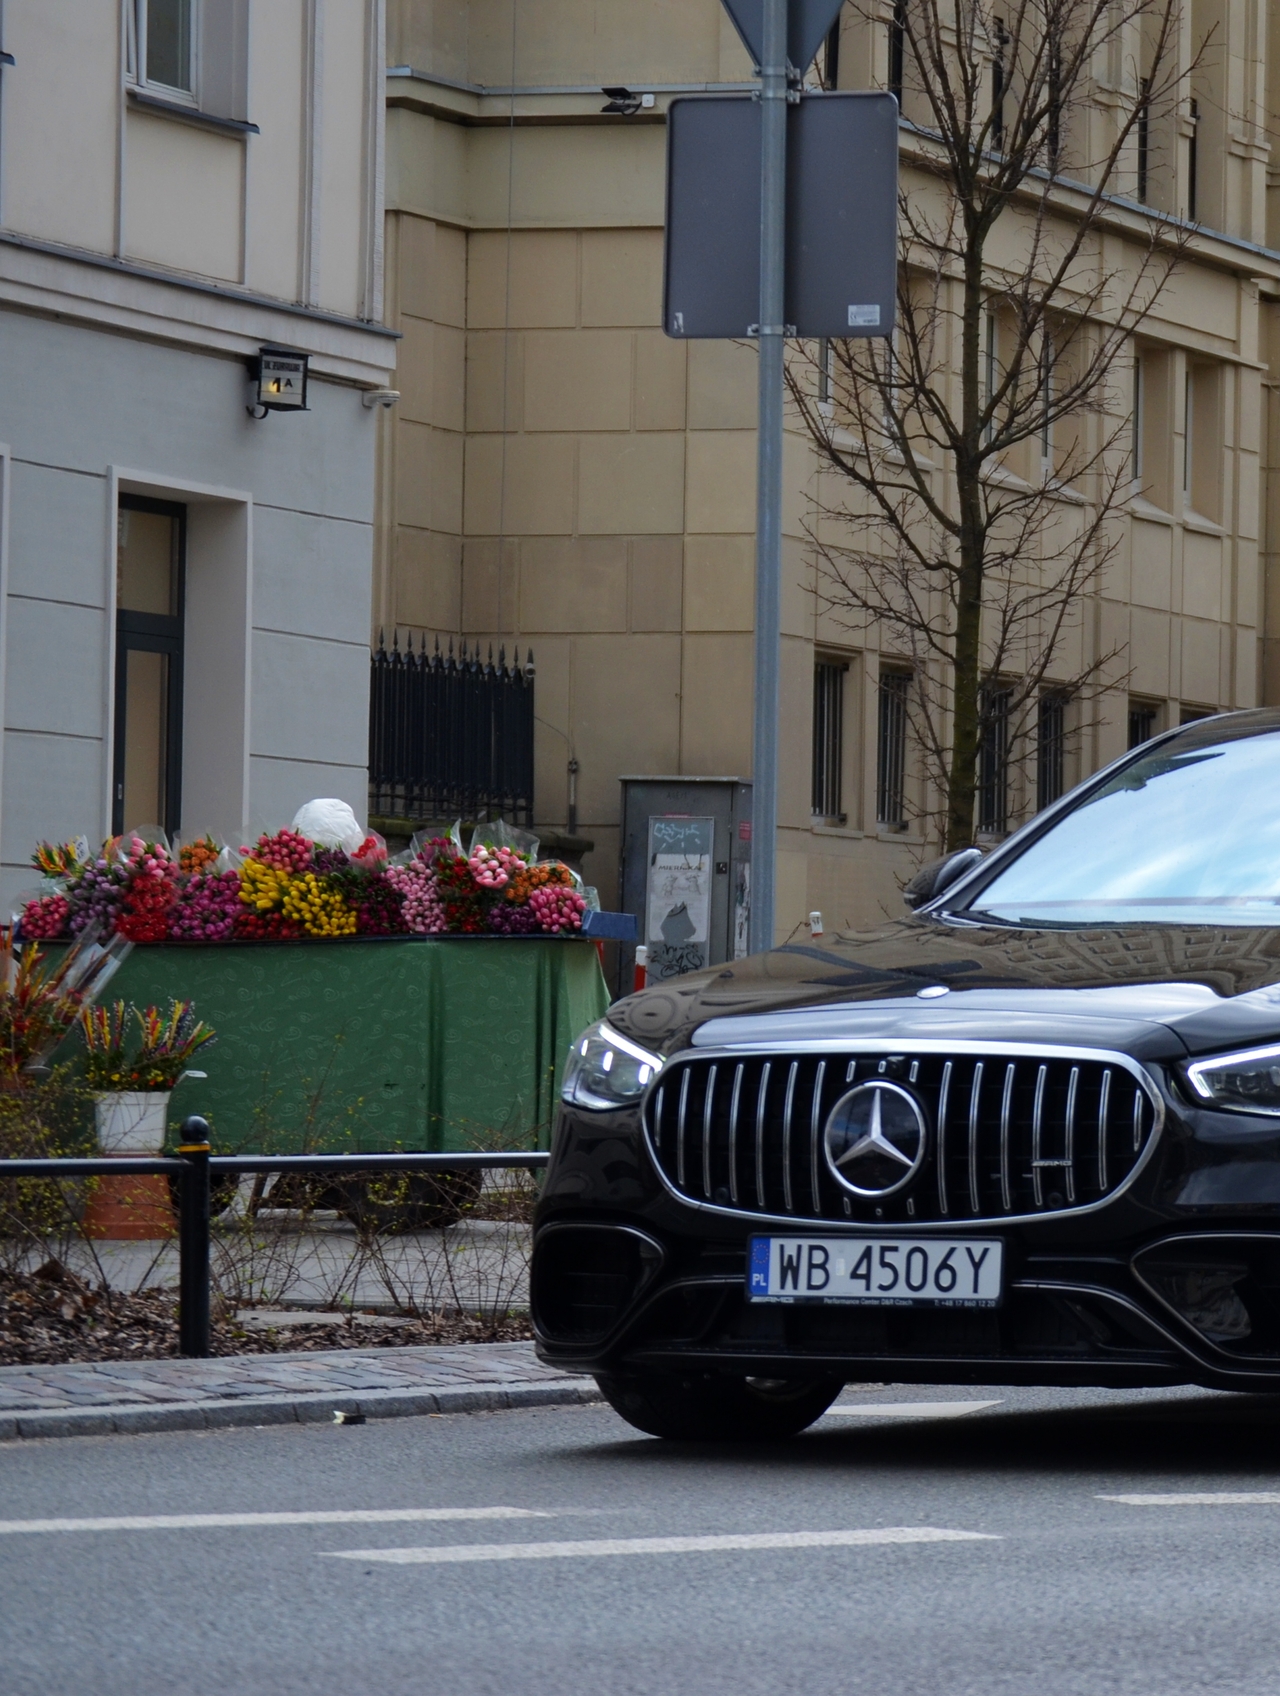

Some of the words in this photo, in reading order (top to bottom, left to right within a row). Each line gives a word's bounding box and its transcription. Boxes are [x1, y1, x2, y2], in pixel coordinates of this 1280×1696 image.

[752, 1273, 767, 1286] PL
[778, 1243, 830, 1291] WB
[849, 1245, 991, 1294] 4506Y
